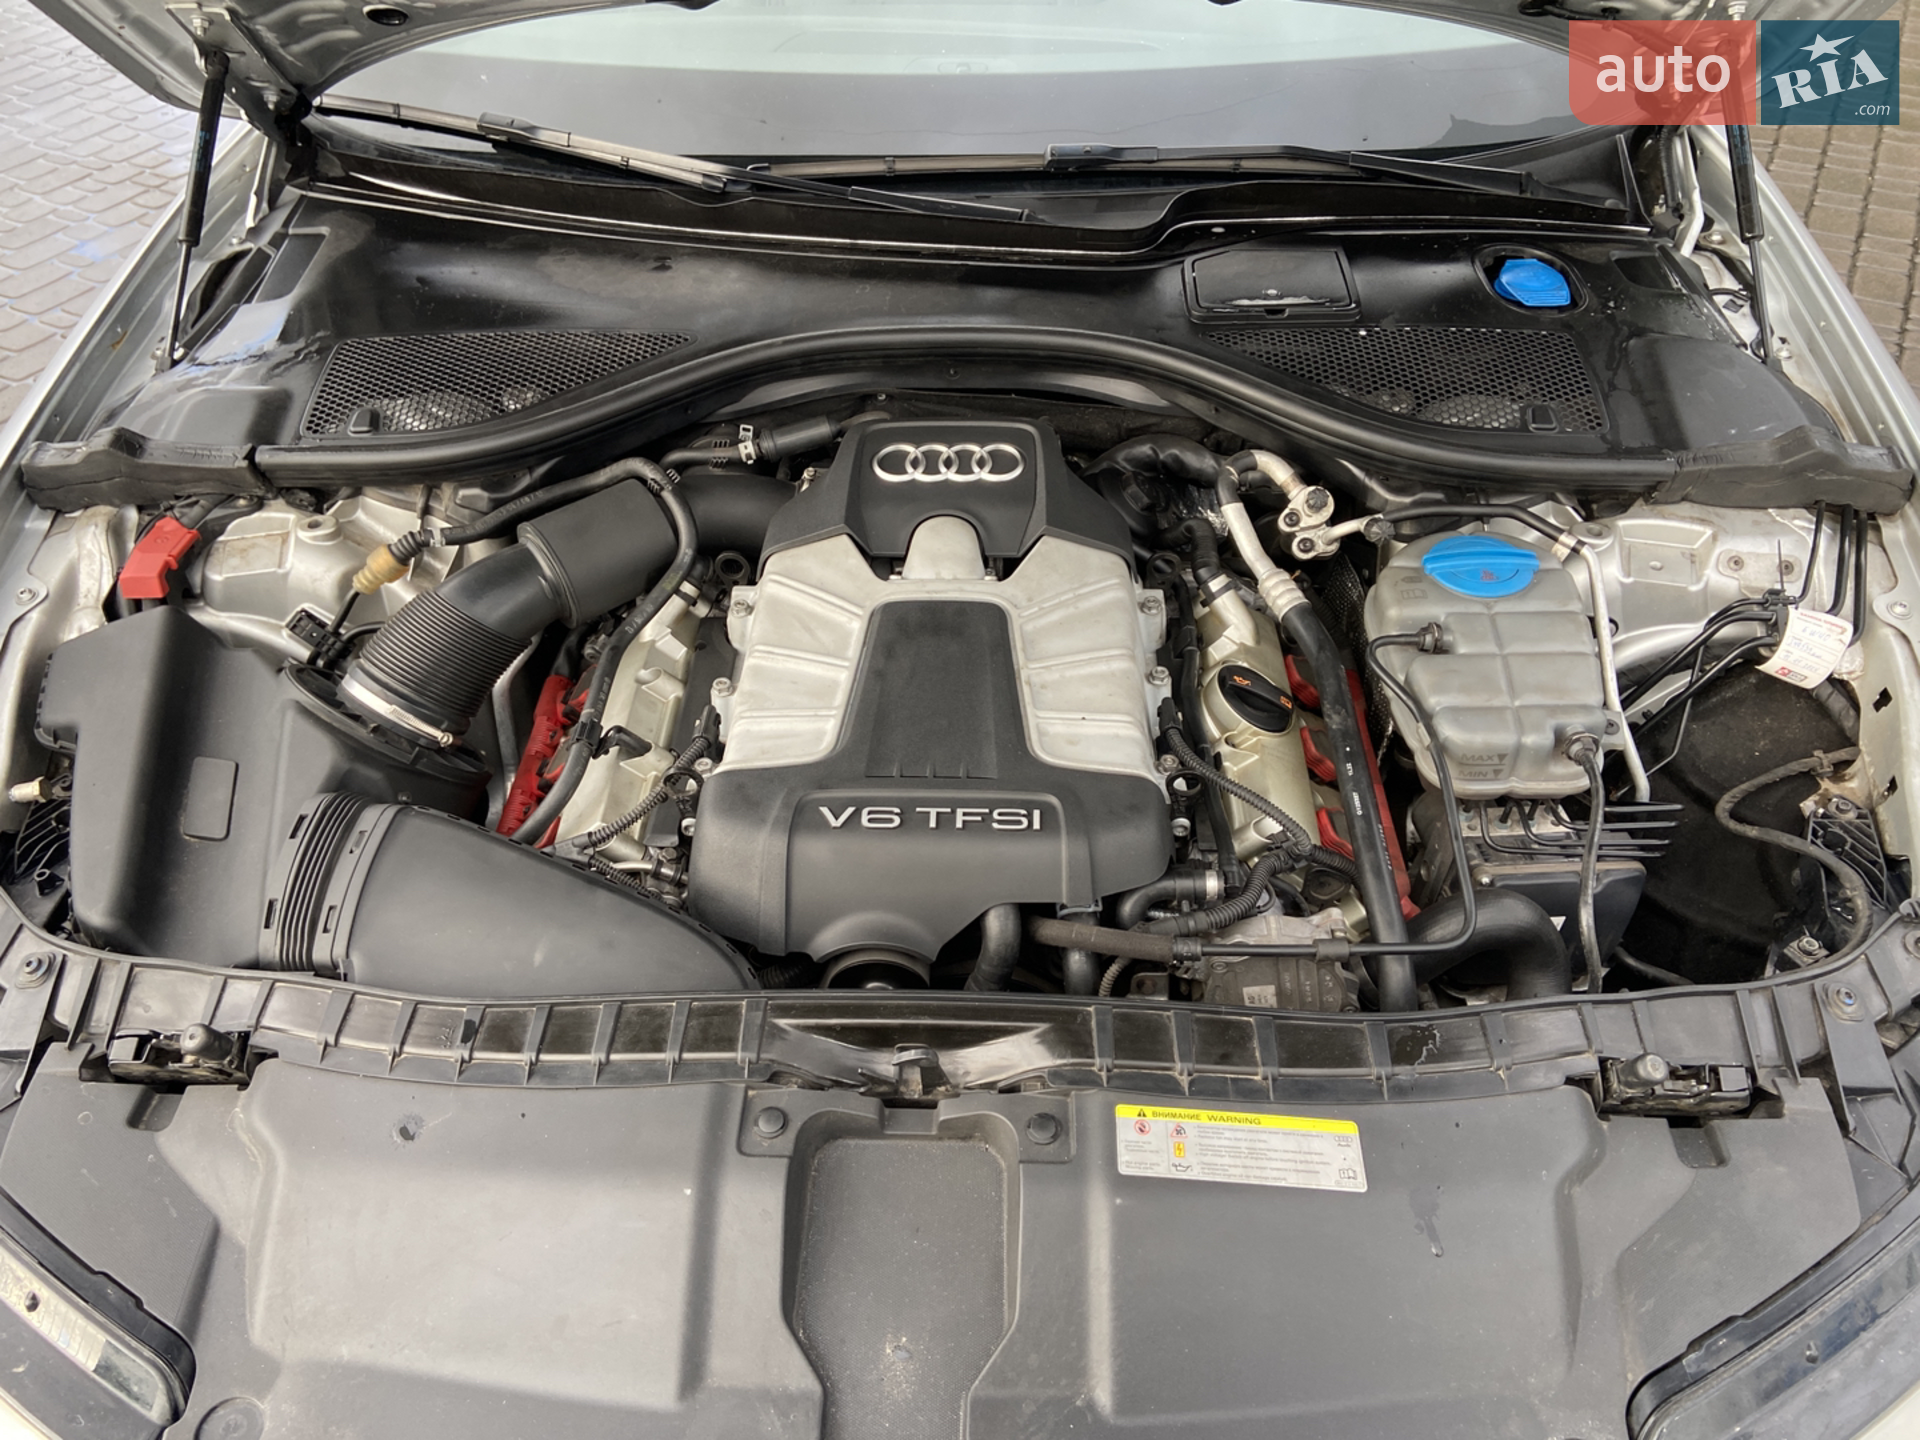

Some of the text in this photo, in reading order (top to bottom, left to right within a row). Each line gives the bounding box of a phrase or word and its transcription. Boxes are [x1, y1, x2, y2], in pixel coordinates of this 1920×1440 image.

[1460, 753, 1495, 762] MAX
[1458, 769, 1488, 778] MIN
[818, 806, 1042, 831] V6 TFSI
[1152, 1110, 1262, 1126] ВНИМАНИЕ WARNING
